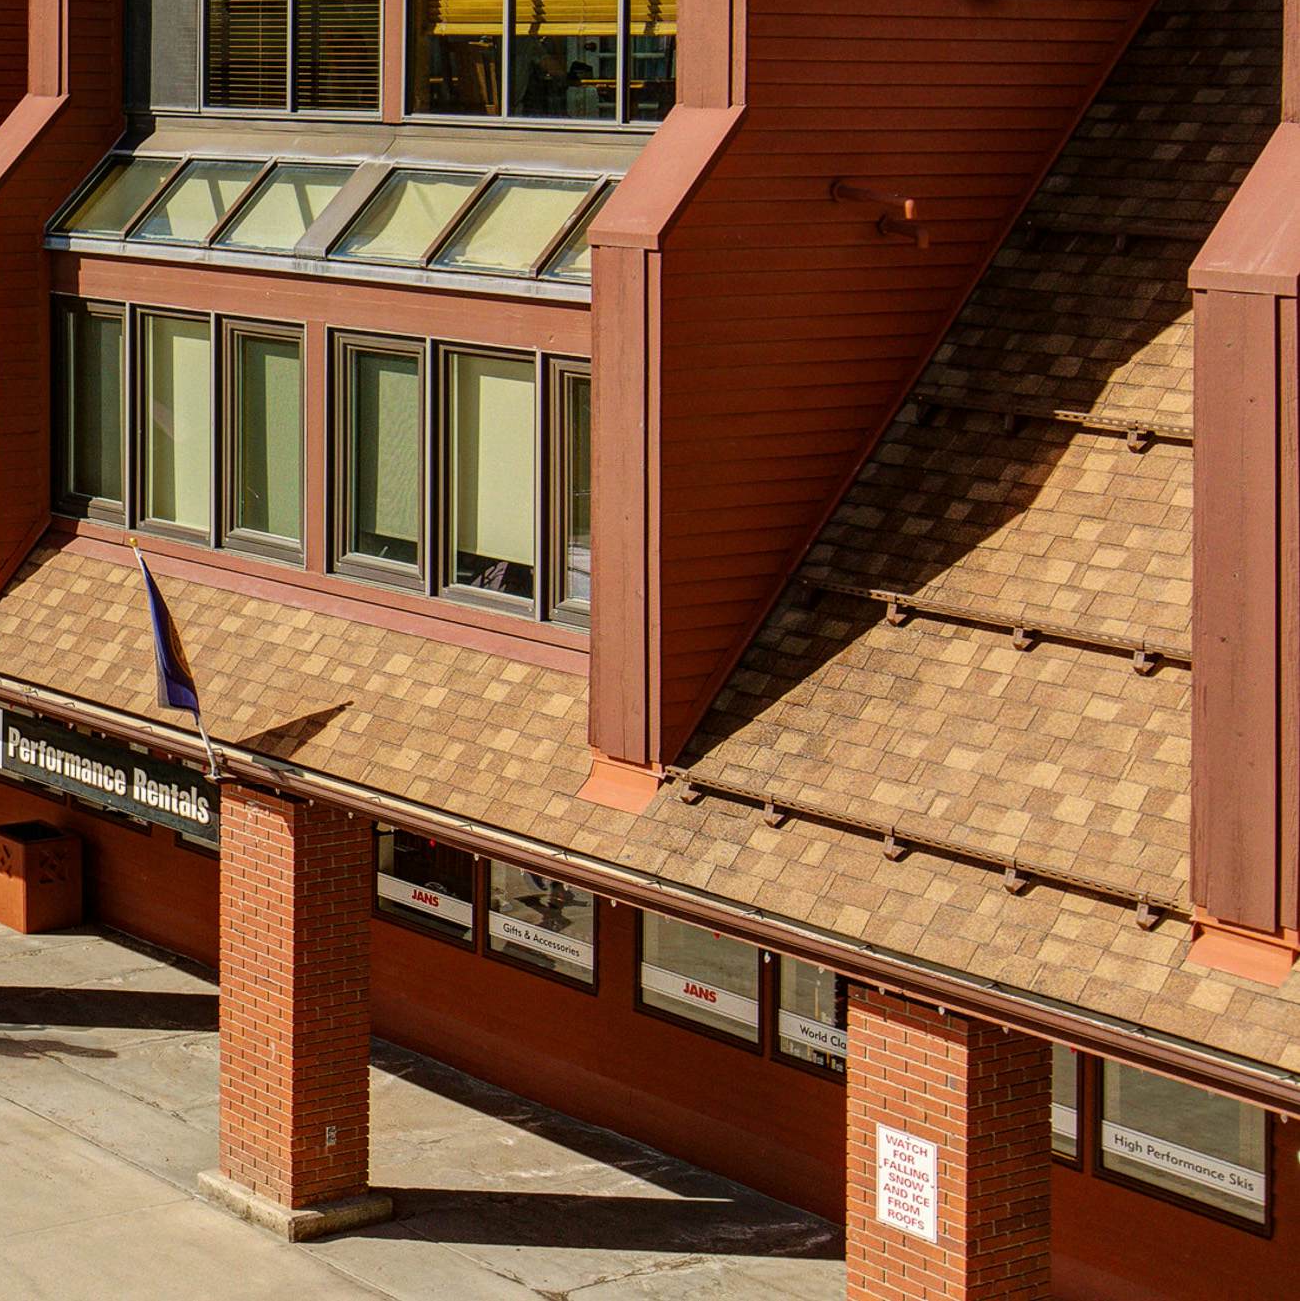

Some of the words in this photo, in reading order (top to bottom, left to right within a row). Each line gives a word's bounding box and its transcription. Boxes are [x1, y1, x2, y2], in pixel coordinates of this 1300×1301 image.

[7, 727, 127, 796] Performance
[133, 767, 211, 825] Rentals
[411, 889, 440, 908] JANS
[502, 922, 522, 939] Gifts
[524, 930, 531, 940] &
[533, 933, 580, 957] Accessories
[683, 982, 718, 1004] JANS
[799, 1024, 827, 1043] World
[885, 1134, 928, 1158] WATCH
[893, 1149, 915, 1165] FOR
[883, 1157, 930, 1183] FALLING
[1114, 1133, 1143, 1154] High
[1147, 1145, 1226, 1182] Performance
[1229, 1172, 1255, 1192] Skis
[888, 1172, 925, 1193] SNOW
[883, 1183, 908, 1199] AND
[912, 1193, 930, 1208] ICE
[887, 1196, 920, 1217] FROM
[887, 1209, 925, 1230] ROOFS
